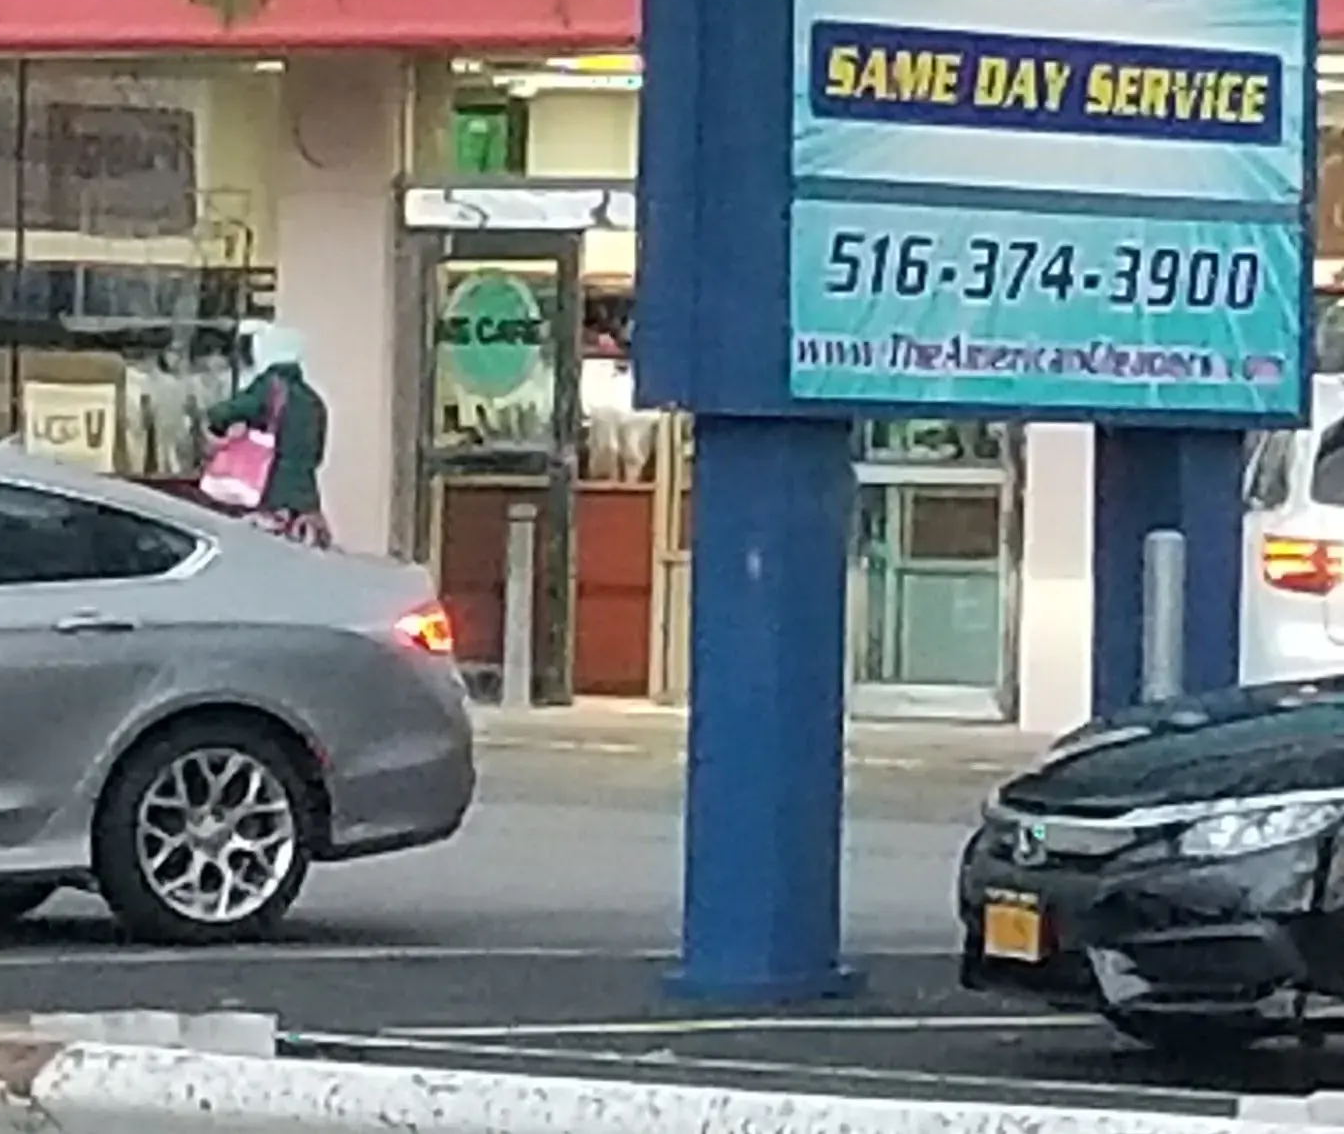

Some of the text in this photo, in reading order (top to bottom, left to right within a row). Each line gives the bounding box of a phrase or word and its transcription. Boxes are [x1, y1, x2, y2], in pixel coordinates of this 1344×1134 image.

[825, 45, 1269, 124] SAME DAY SERVICE
[824, 232, 1260, 310] 516-374-3900
